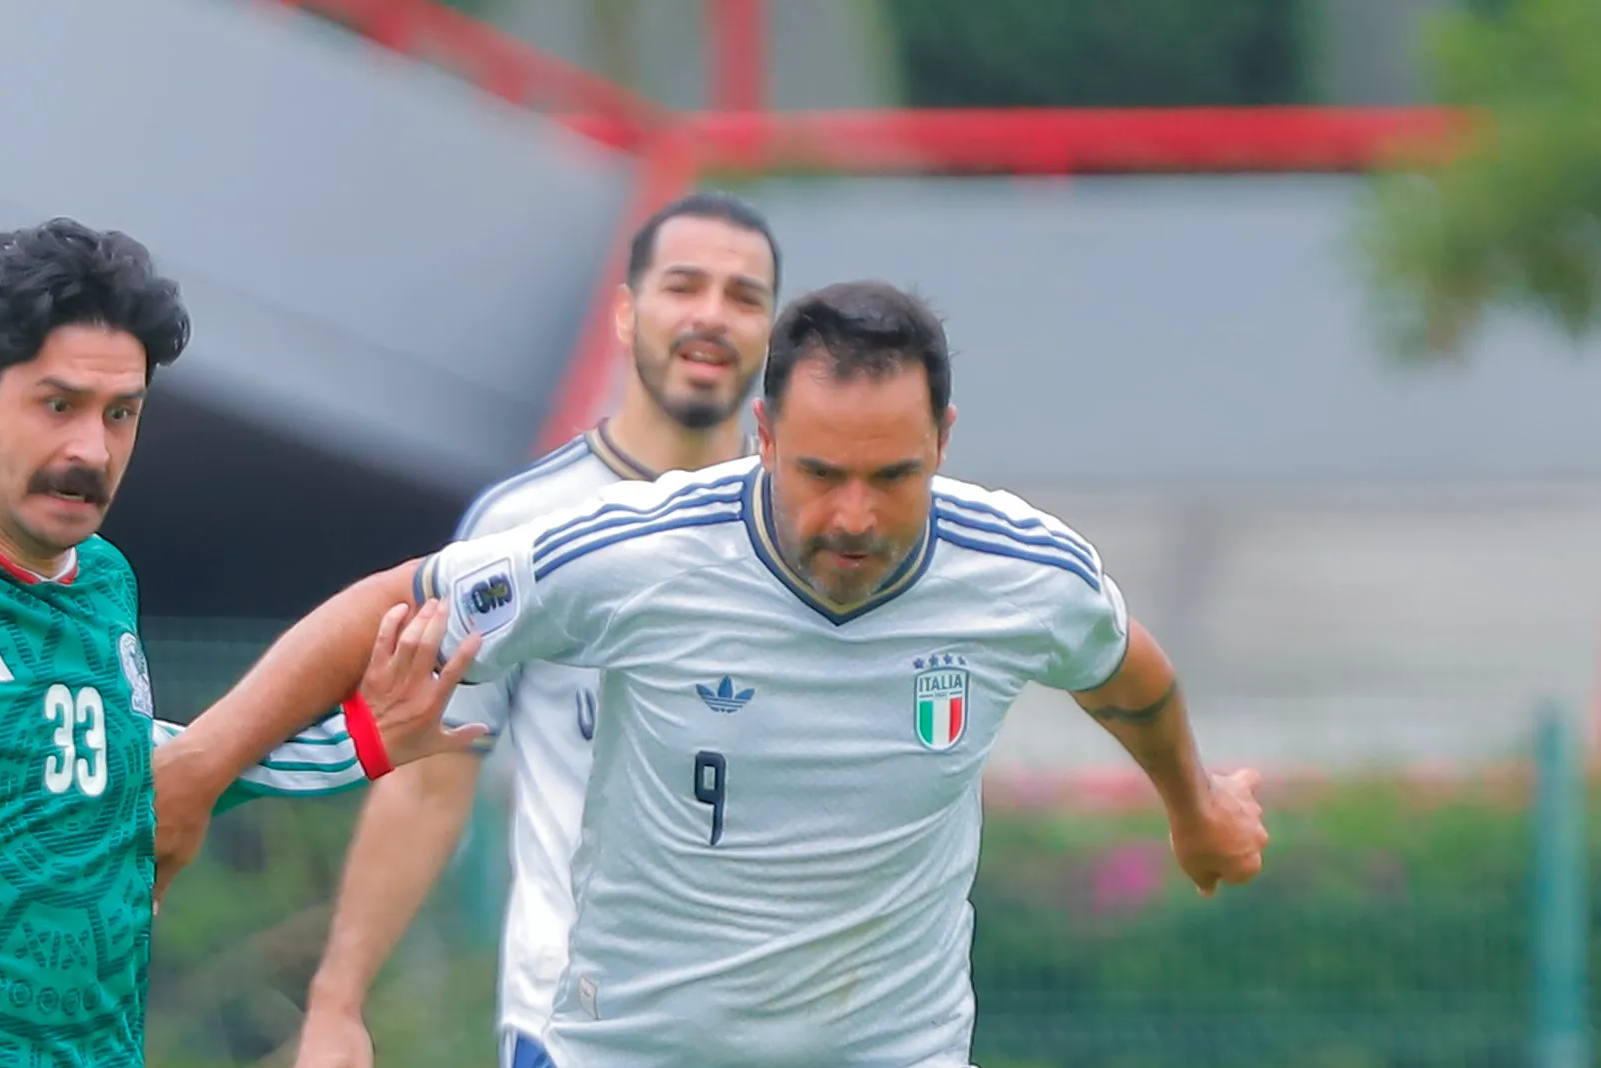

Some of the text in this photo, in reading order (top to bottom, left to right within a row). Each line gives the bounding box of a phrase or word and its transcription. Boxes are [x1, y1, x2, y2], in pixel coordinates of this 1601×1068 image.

[919, 674, 963, 693] ITALIA
[44, 683, 107, 797] 33
[694, 750, 726, 846] 9
